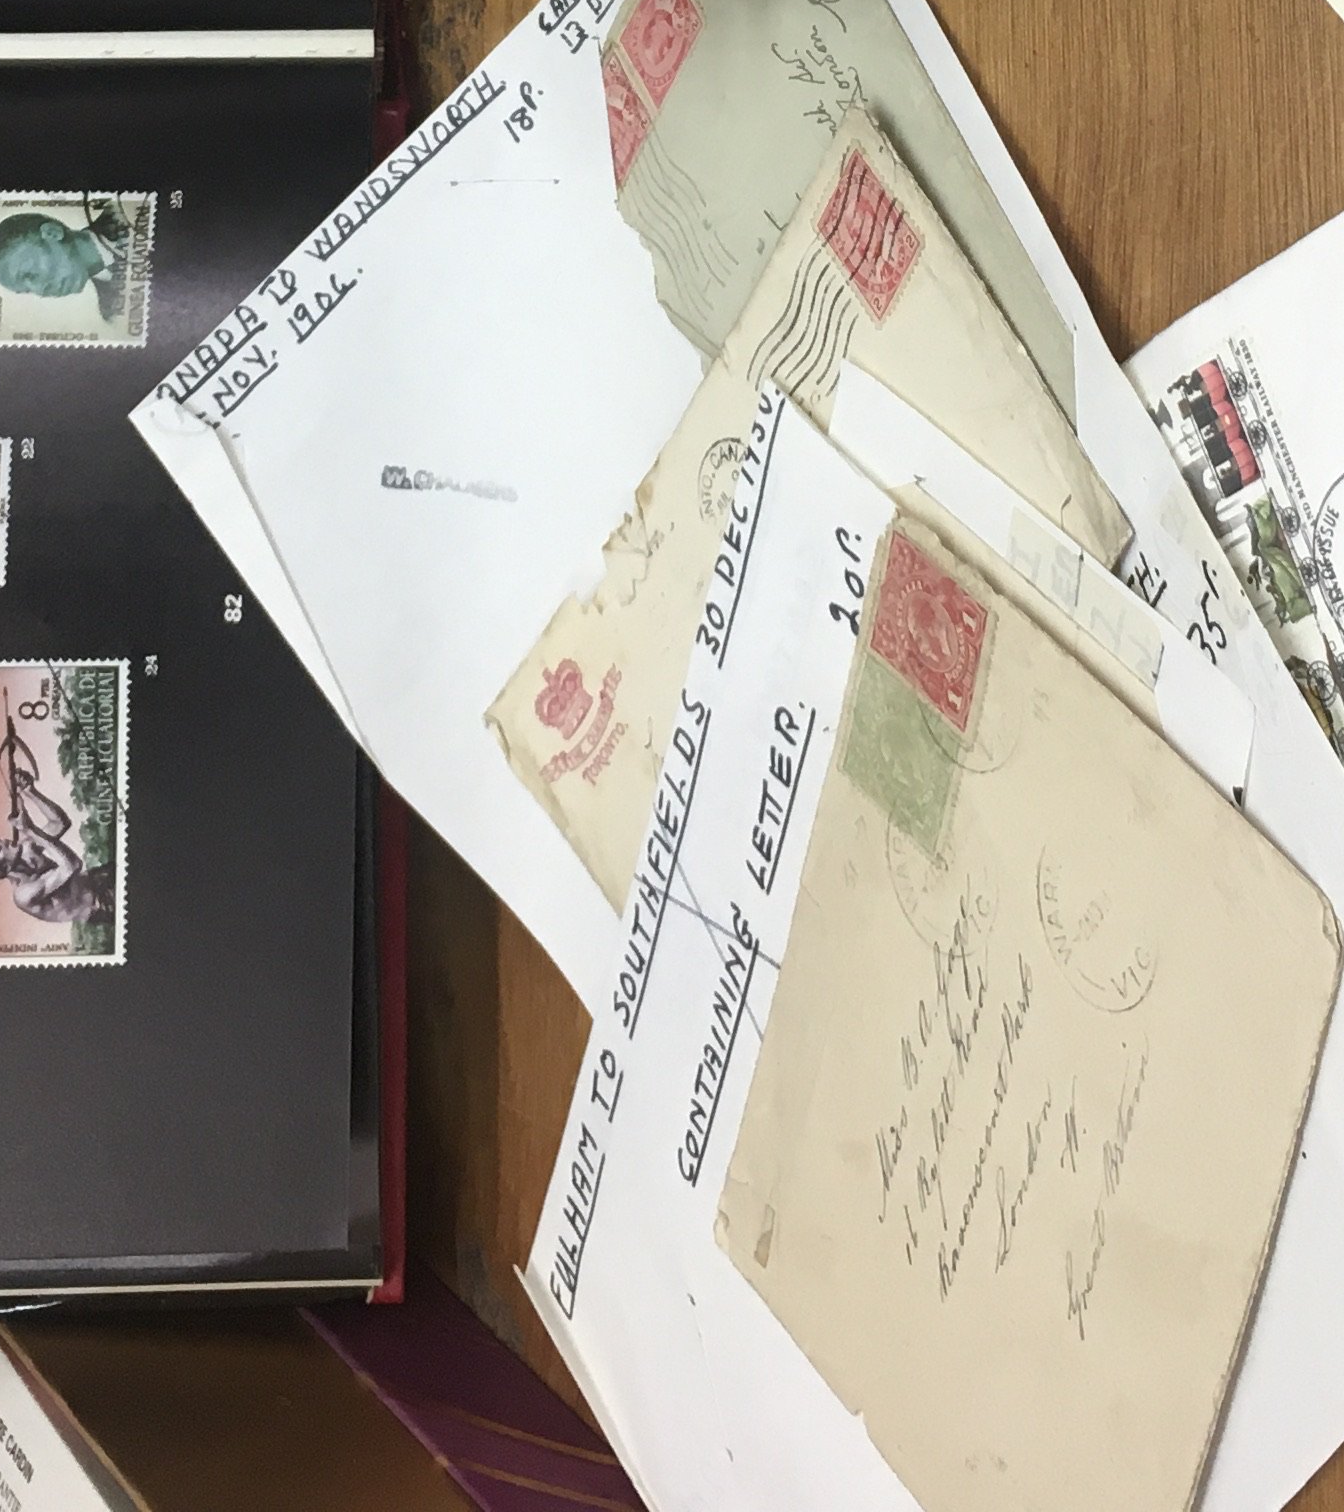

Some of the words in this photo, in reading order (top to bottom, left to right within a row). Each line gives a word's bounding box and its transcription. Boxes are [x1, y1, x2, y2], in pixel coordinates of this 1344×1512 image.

[258, 269, 298, 306] TO
[1248, 366, 1274, 417] RAILWAY
[1272, 419, 1306, 499] MANCHESTER
[225, 593, 243, 623] 82
[144, 654, 159, 676] 24
[18, 700, 49, 721] 8
[549, 1122, 602, 1314] FULHAM
[590, 1047, 622, 1113] TO
[612, 688, 707, 1029] SOUTHFIELDS
[694, 601, 727, 656] 30
[711, 503, 749, 587] DEC
[675, 900, 758, 1186] CONTAINING
[993, 1080, 1053, 1271] London
[5, 1434, 34, 1484] CARDIN
